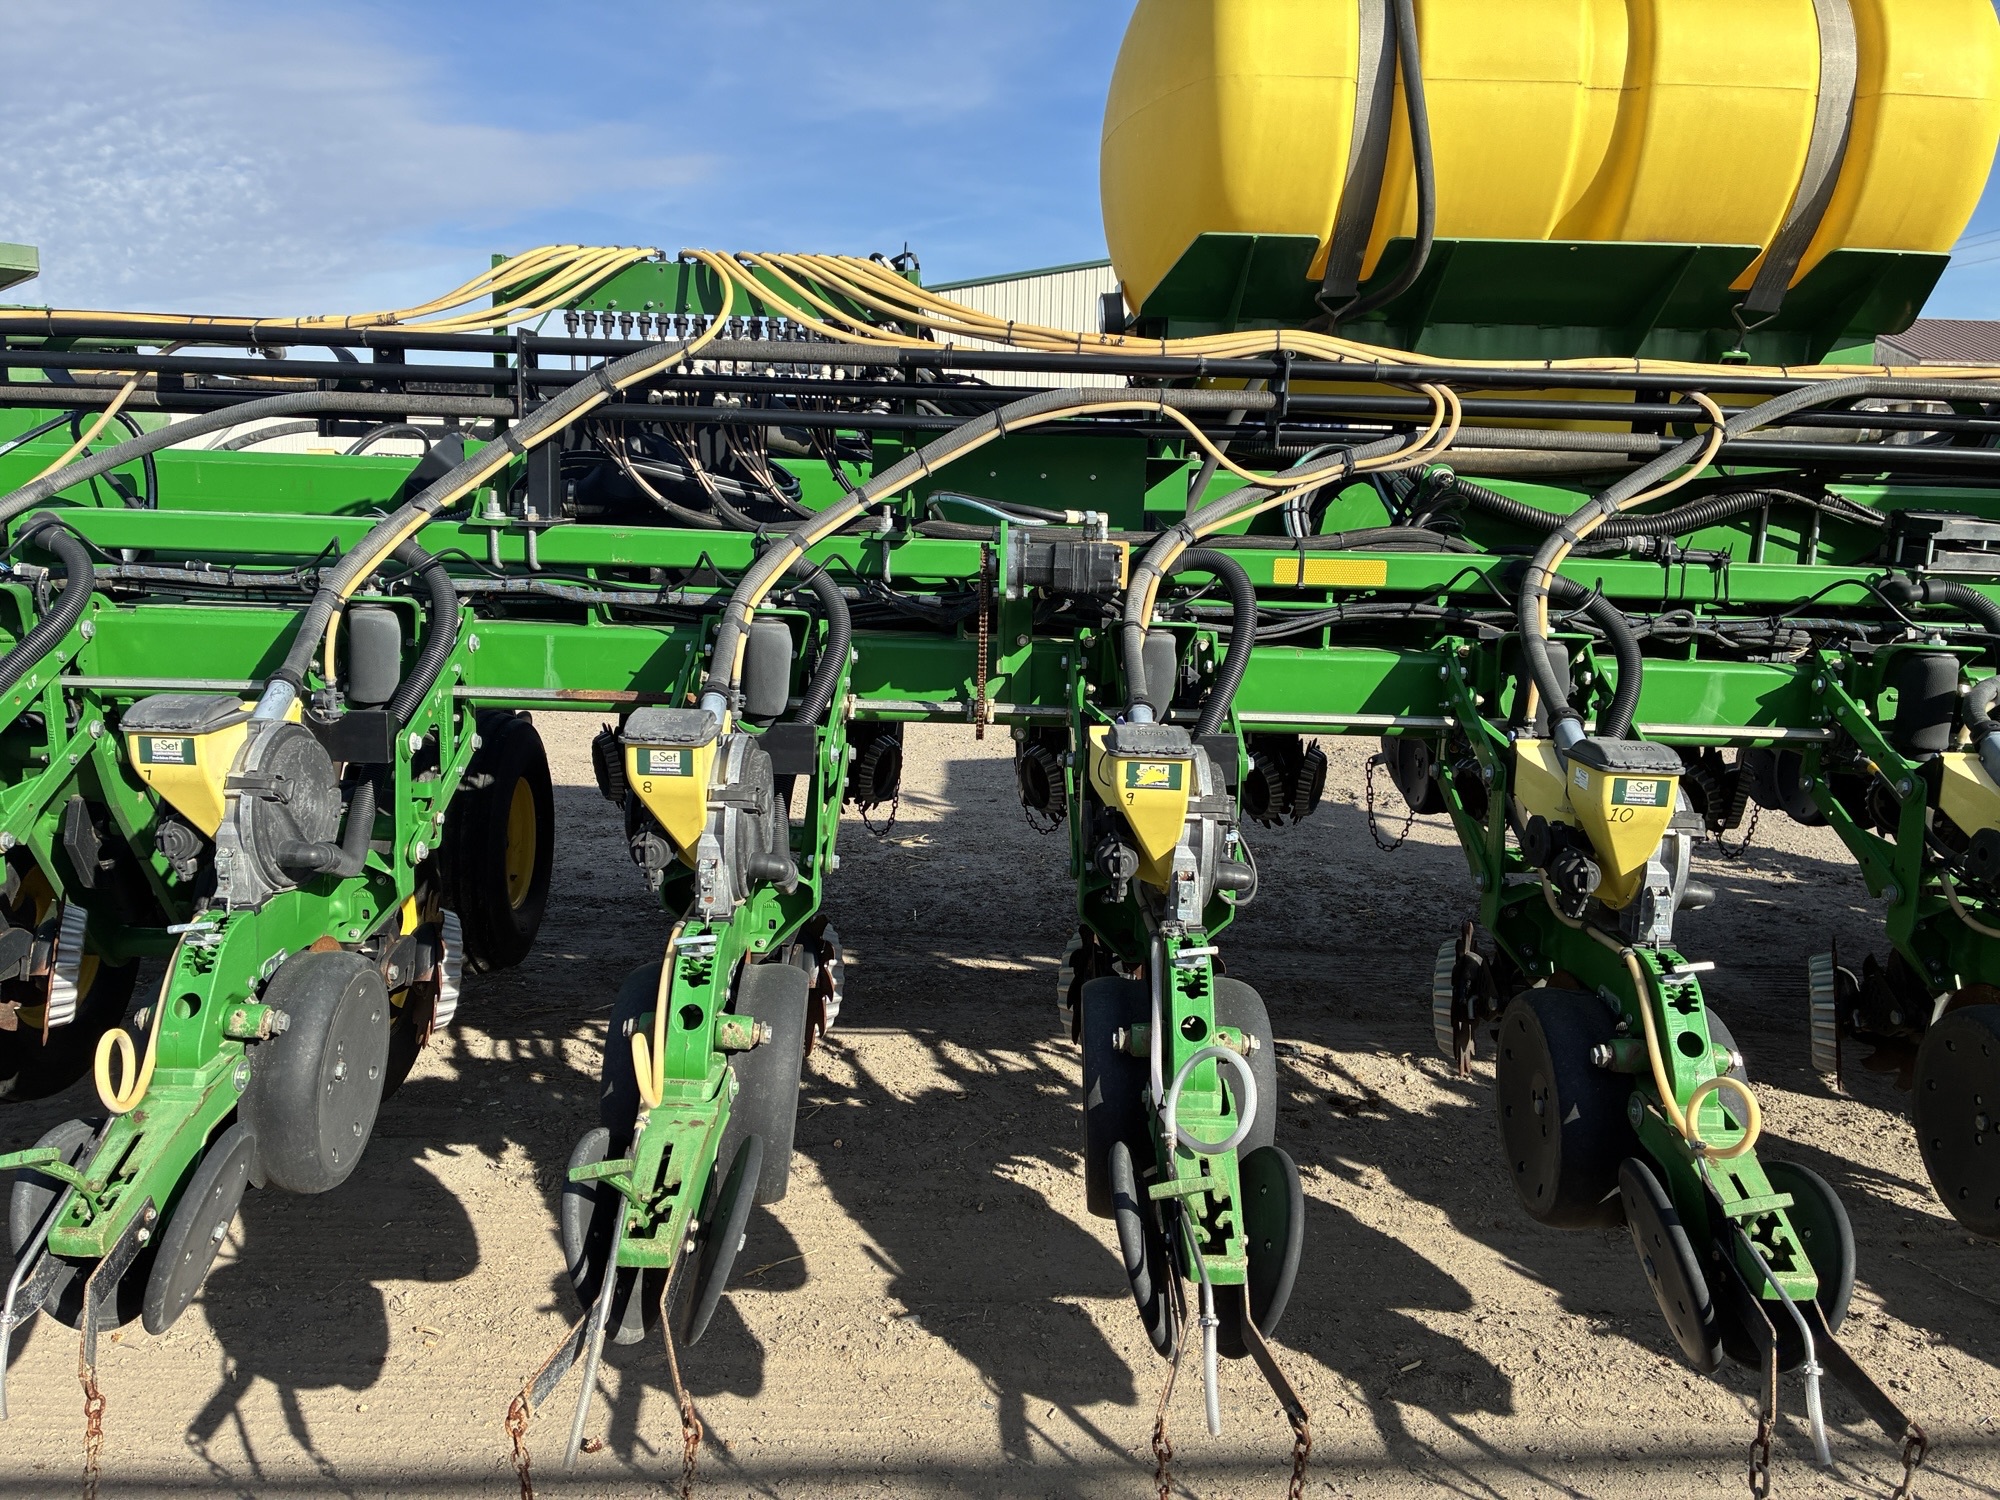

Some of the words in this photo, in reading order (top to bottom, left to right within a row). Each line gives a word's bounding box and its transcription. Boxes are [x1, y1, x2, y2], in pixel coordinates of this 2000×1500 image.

[153, 739, 179, 751] eSet
[652, 751, 677, 762] eSet
[143, 769, 152, 780] 7
[642, 781, 652, 793] 8
[1629, 781, 1654, 793] eSet
[1126, 792, 1135, 805] 9
[1606, 807, 1634, 823] 10
